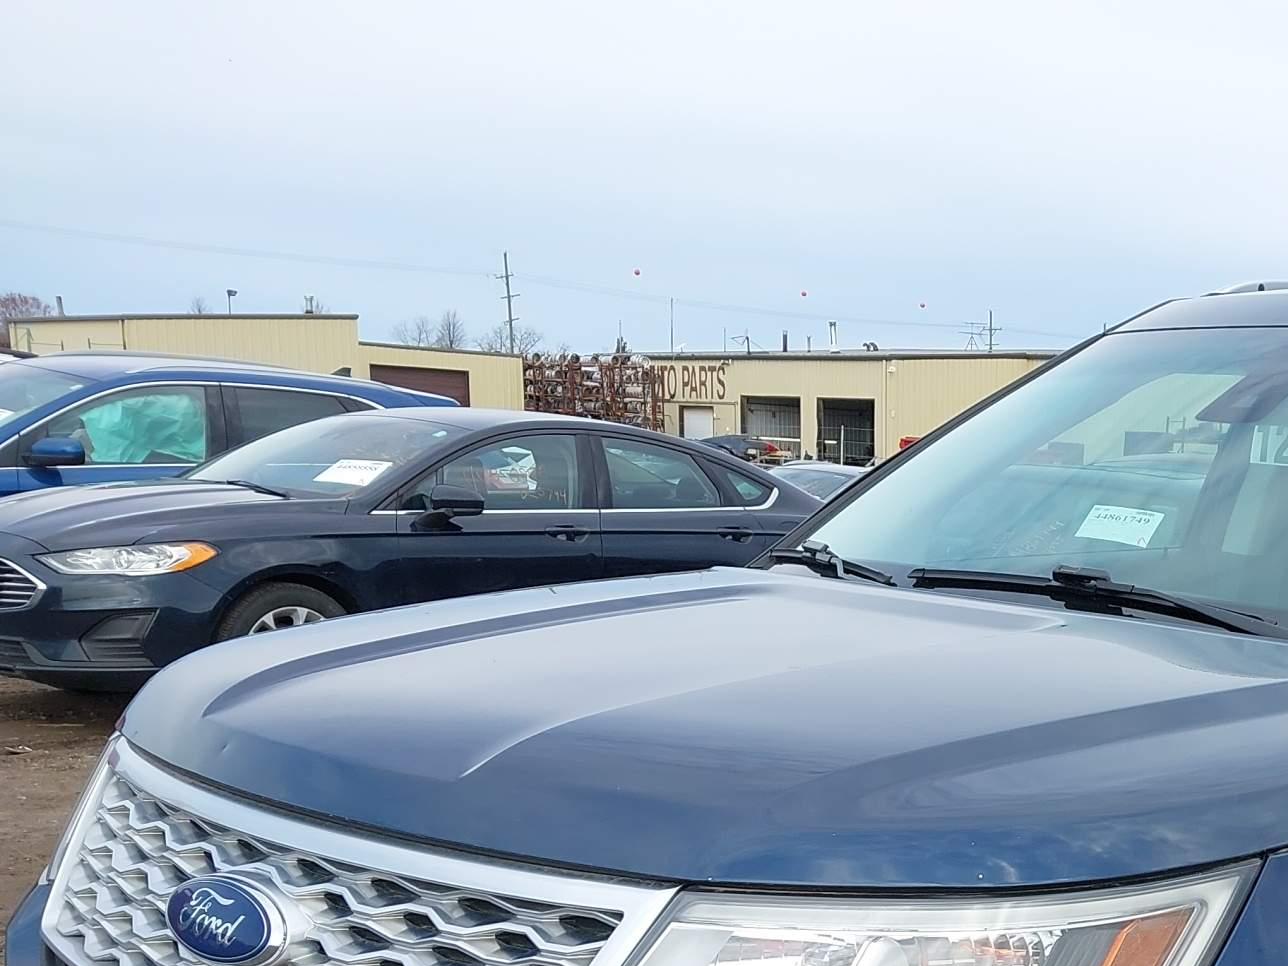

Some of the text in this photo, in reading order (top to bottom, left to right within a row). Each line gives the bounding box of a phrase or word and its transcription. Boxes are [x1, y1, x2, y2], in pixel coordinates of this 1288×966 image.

[682, 365, 726, 399] PARTS
[1094, 512, 1151, 524] 44861749
[180, 887, 245, 945] Ford
